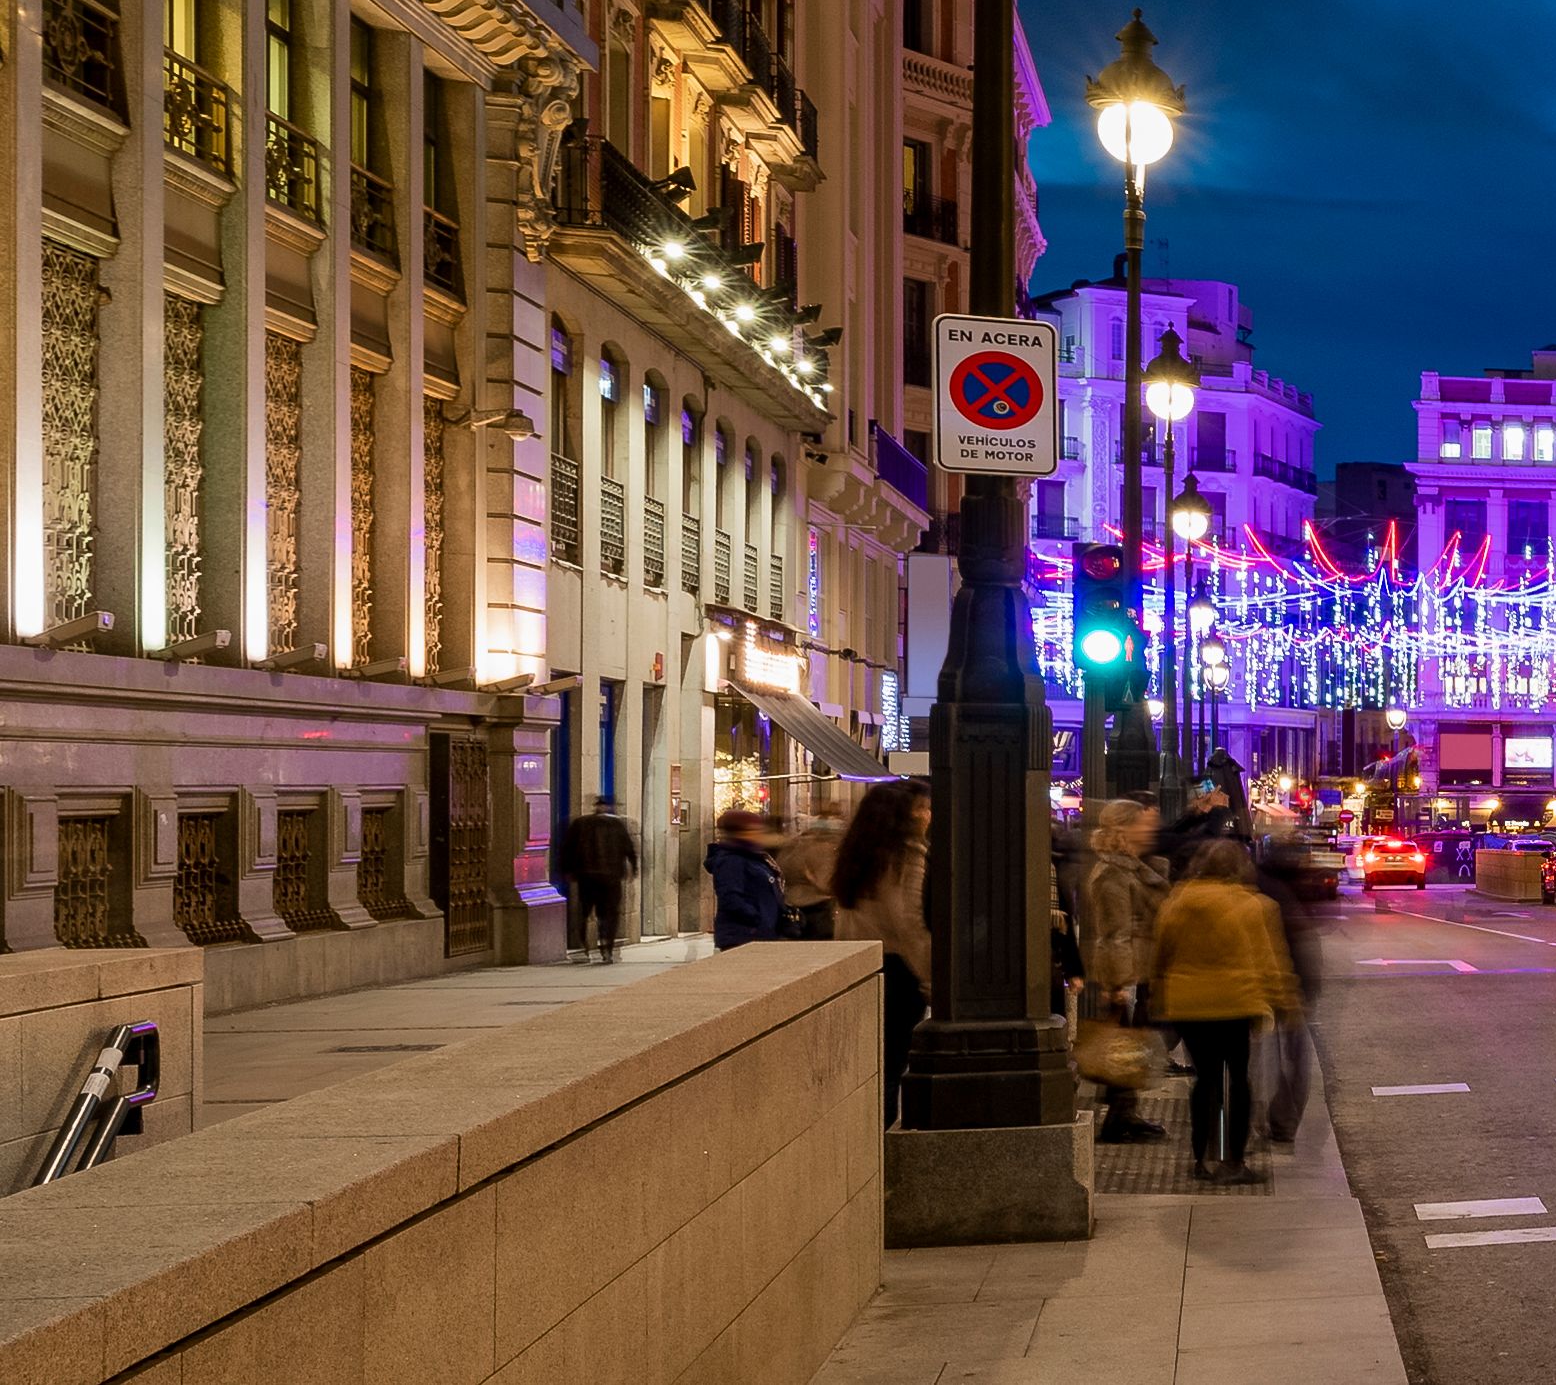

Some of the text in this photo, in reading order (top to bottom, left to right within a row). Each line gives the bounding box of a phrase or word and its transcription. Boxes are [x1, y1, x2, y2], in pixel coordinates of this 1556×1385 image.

[949, 329, 1043, 348] EN ACERA
[958, 434, 1037, 448] VEHÍCULOS
[960, 449, 1034, 462] DE MOTOR
